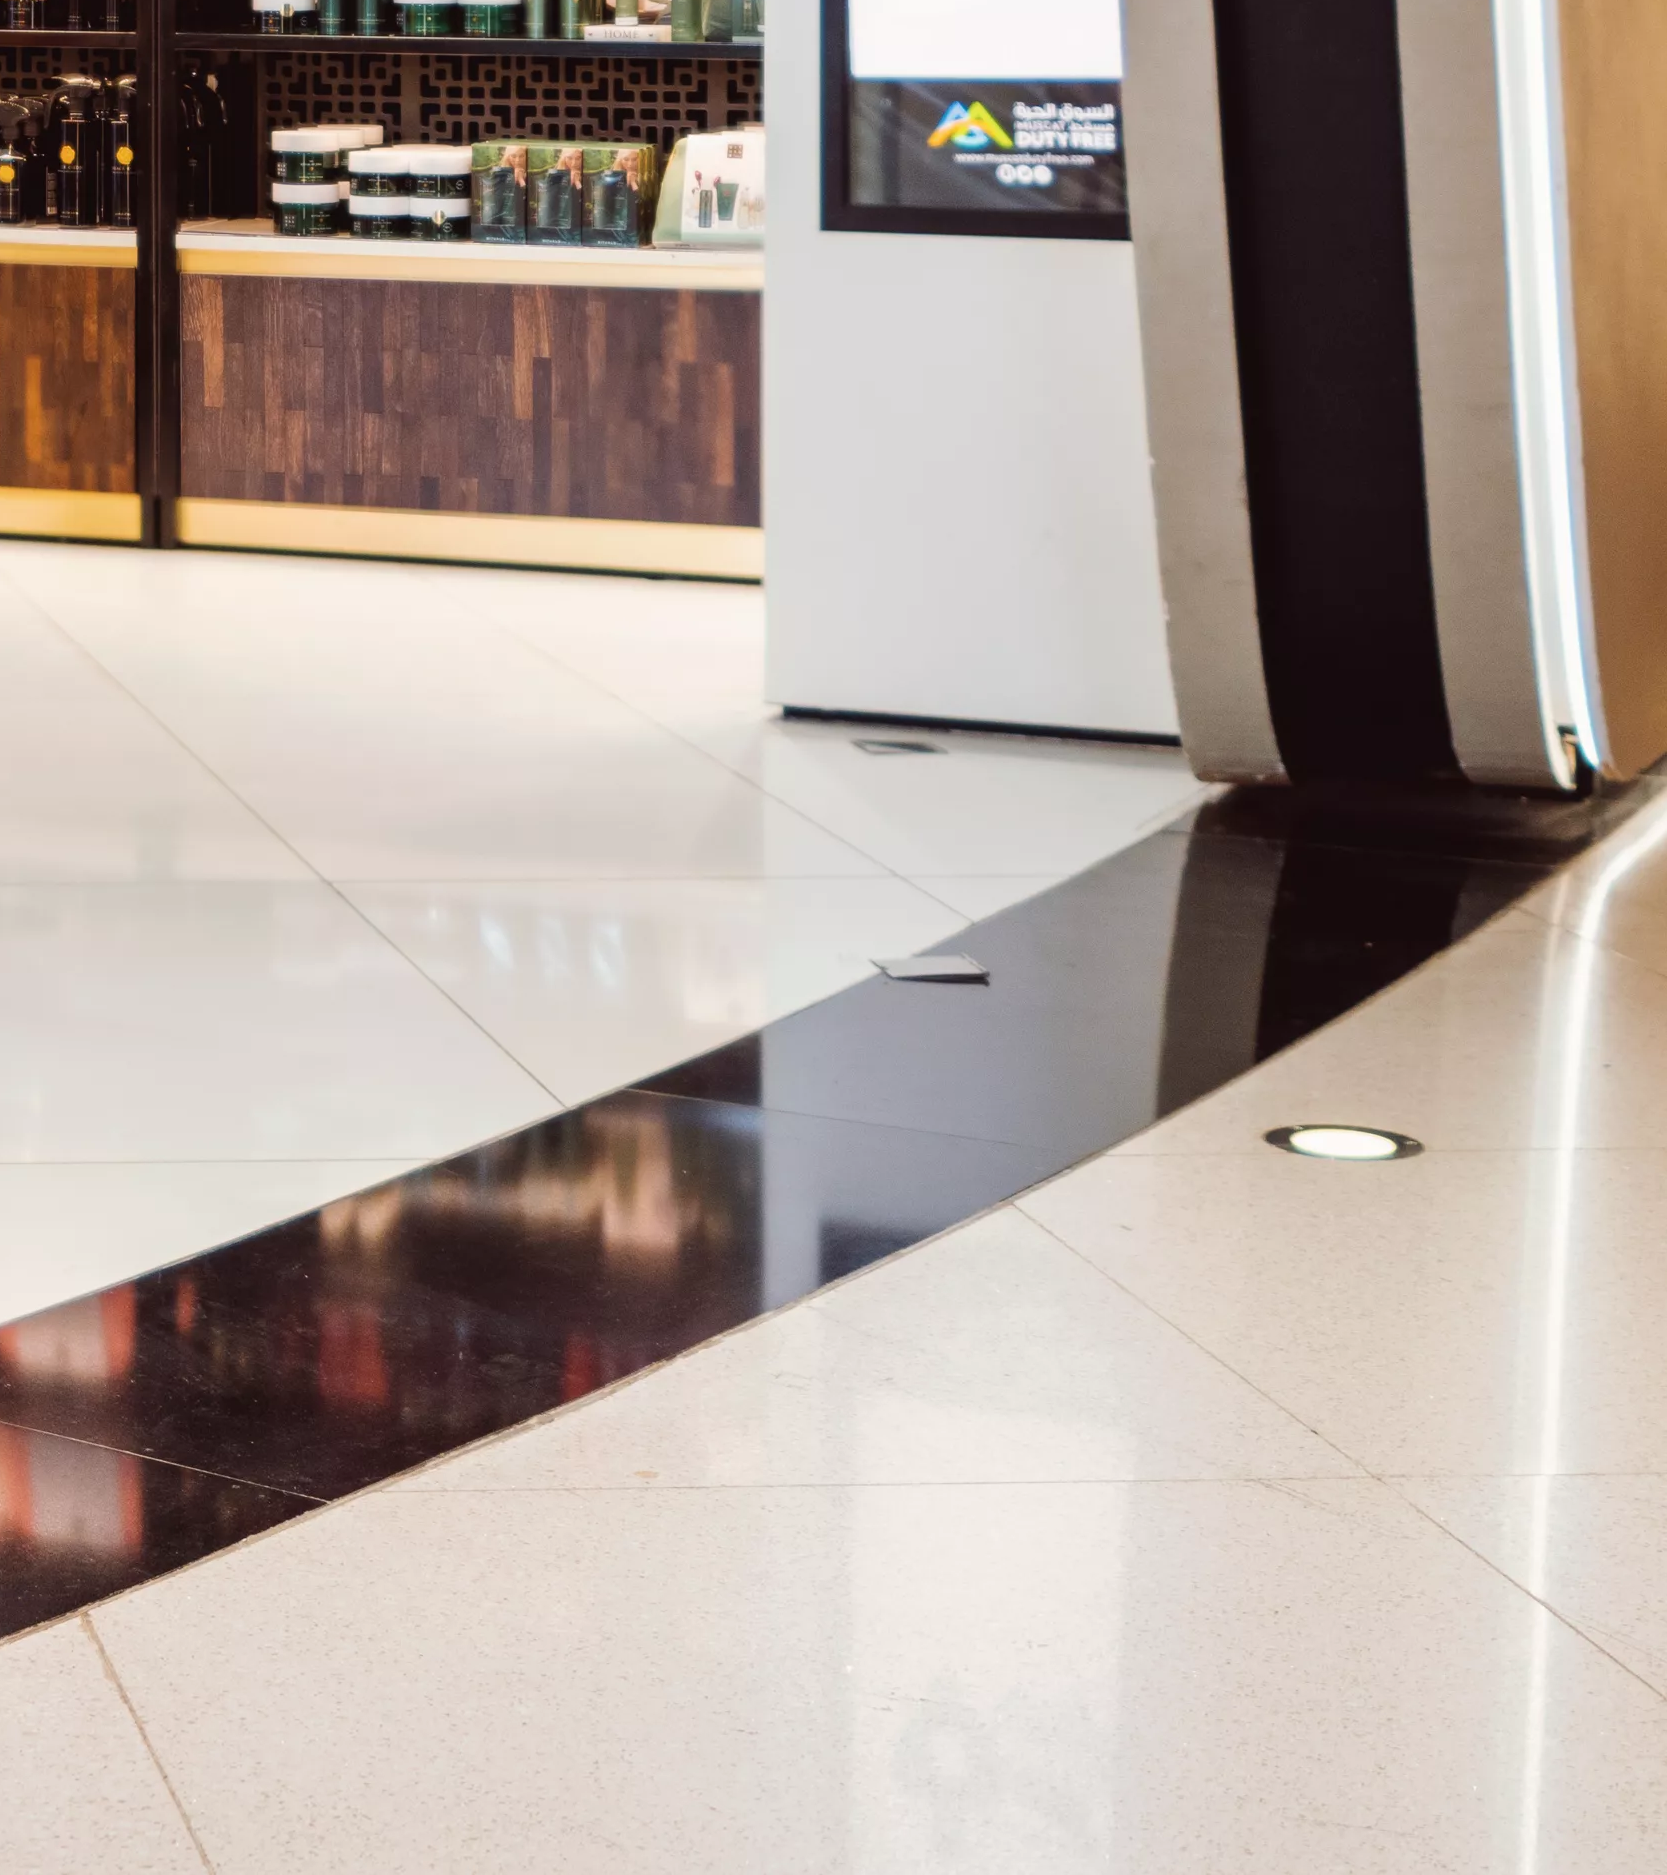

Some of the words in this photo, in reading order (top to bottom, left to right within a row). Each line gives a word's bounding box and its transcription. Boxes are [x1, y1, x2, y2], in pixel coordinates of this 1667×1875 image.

[604, 29, 638, 40] HOME
[1014, 130, 1069, 149] DUTY
[1071, 131, 1117, 151] FREE
